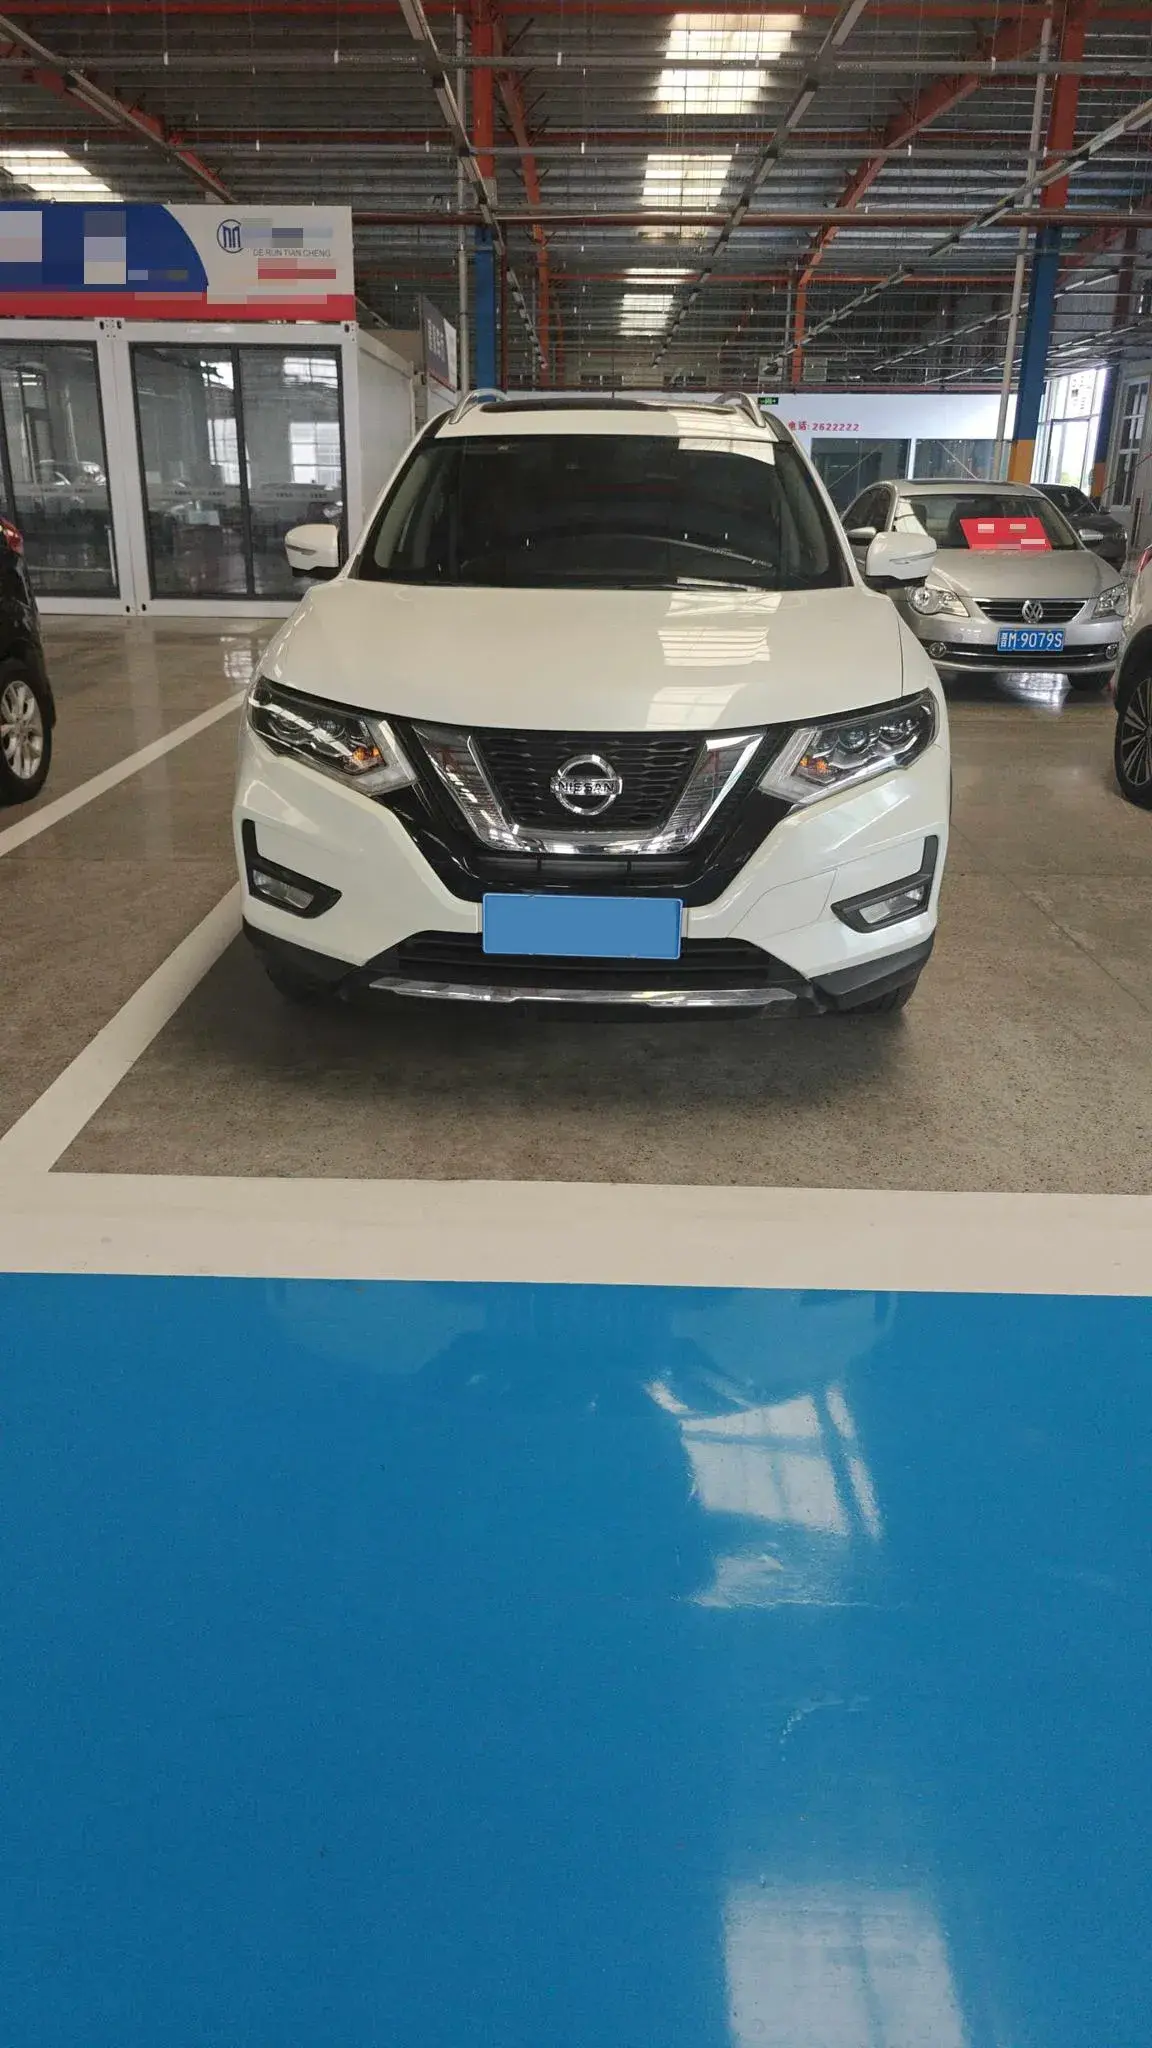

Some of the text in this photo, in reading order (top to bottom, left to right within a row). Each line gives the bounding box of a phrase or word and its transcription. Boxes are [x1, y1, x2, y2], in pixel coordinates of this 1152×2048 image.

[253, 248, 264, 257] DE
[266, 248, 283, 257] RUN
[303, 248, 331, 257] CHENG
[558, 781, 614, 793] NISSAN
